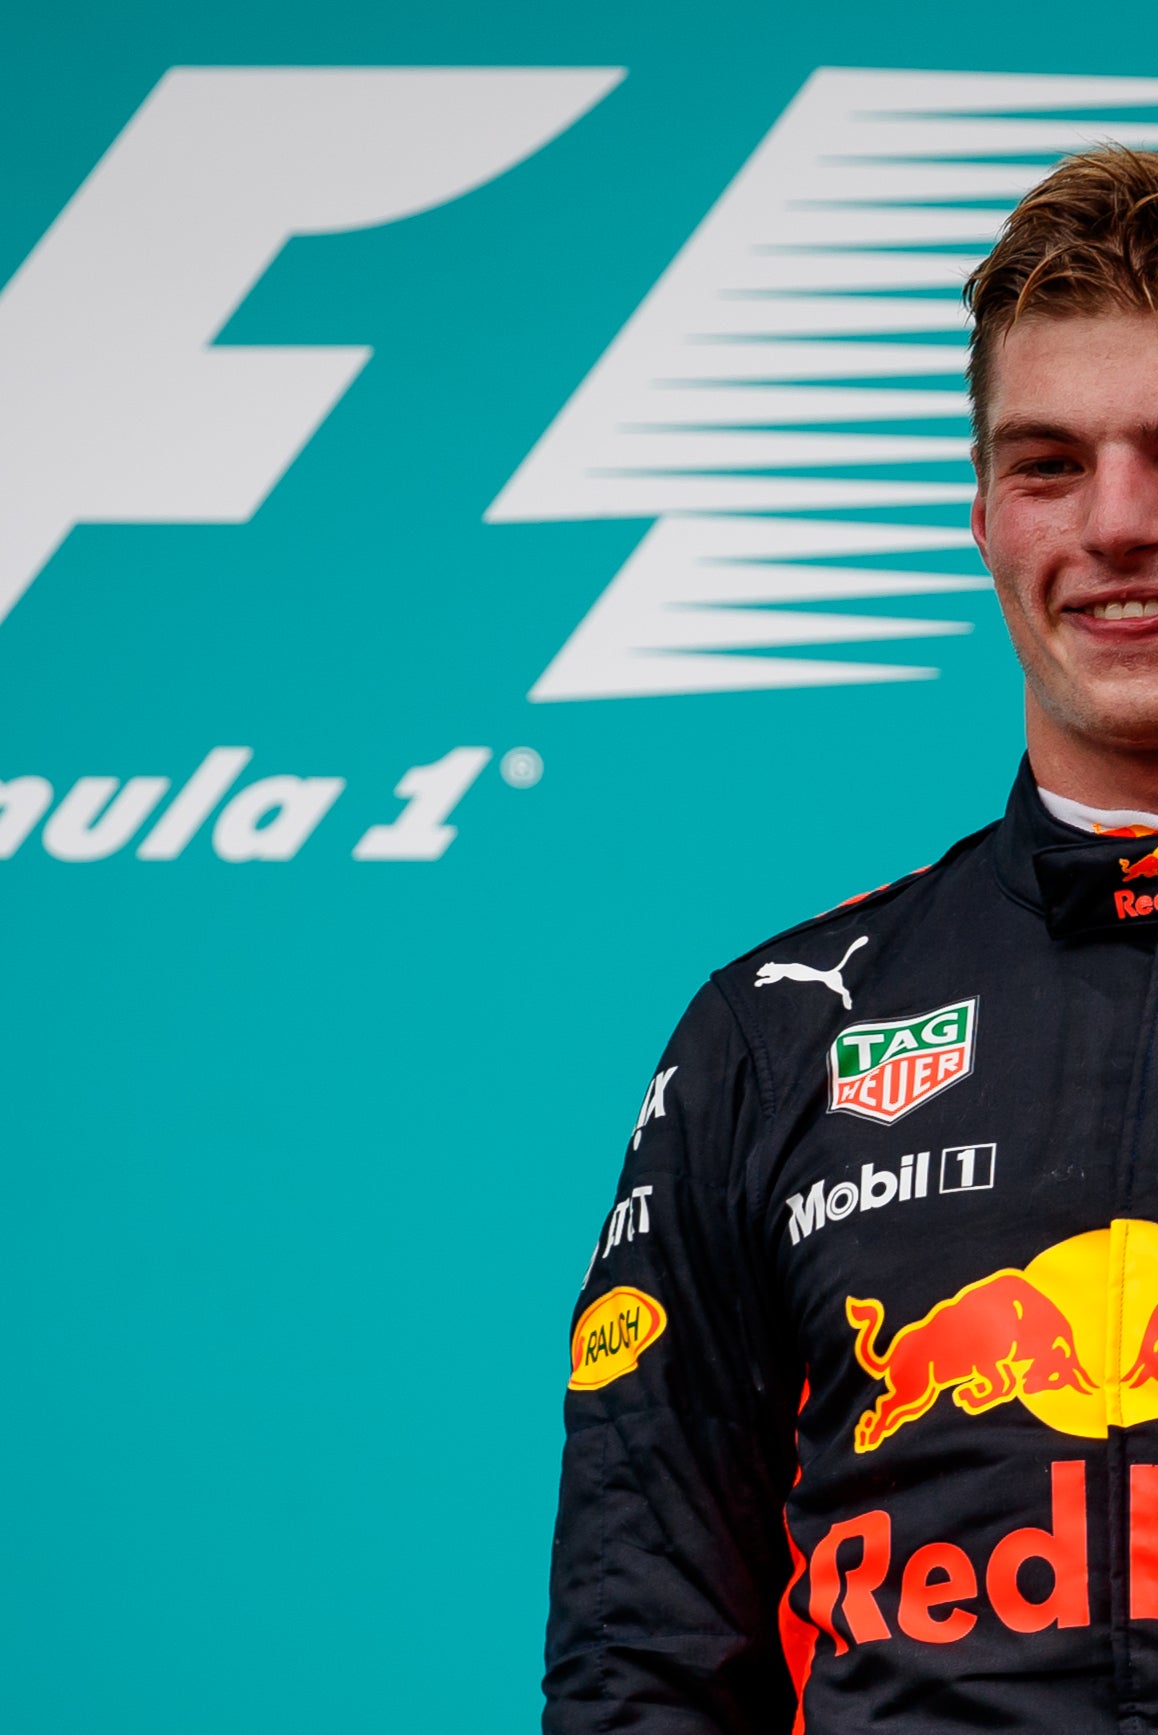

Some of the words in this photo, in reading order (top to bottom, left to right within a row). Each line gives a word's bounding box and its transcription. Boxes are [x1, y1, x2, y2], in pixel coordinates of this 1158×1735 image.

[353, 746, 492, 860] 1
[841, 1050, 961, 1112] HEUER
[843, 1012, 959, 1072] TAG
[785, 1151, 931, 1247] Mobil
[956, 1148, 976, 1188] 1
[584, 1305, 640, 1367] RAUCH
[808, 1459, 1090, 1657] Red
